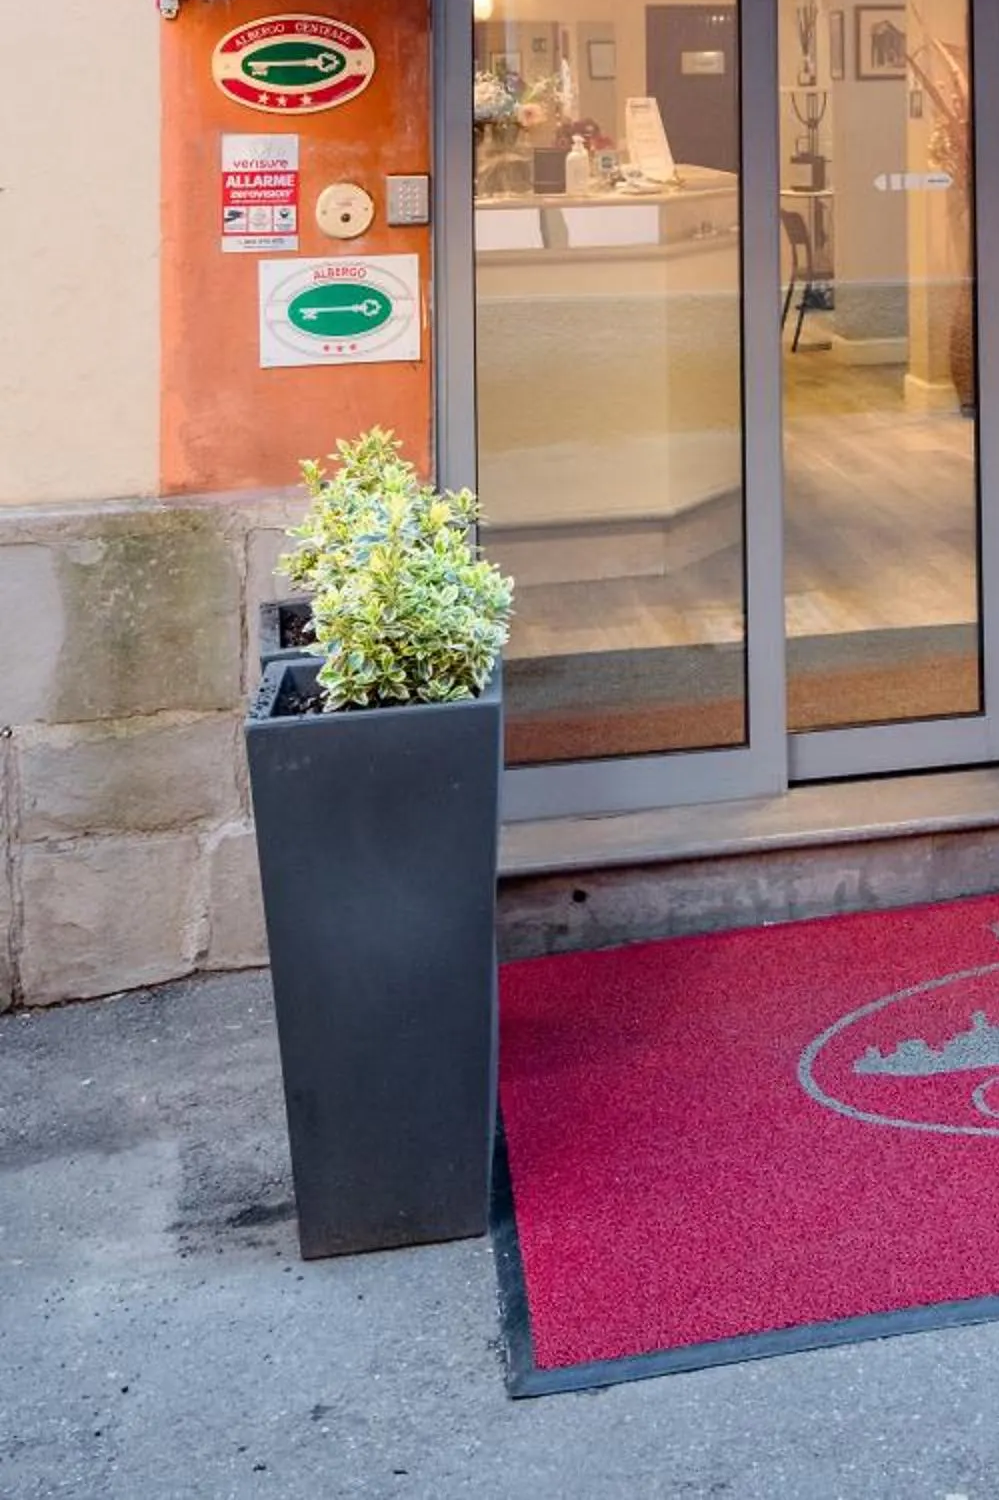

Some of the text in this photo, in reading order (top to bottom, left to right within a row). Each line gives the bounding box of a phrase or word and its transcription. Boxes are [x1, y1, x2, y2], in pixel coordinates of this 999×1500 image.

[235, 23, 353, 47] ALBERGO CENTRALE
[233, 159, 289, 169] verisure
[225, 174, 296, 189] ALLARME
[313, 267, 367, 281] ALBERGO
